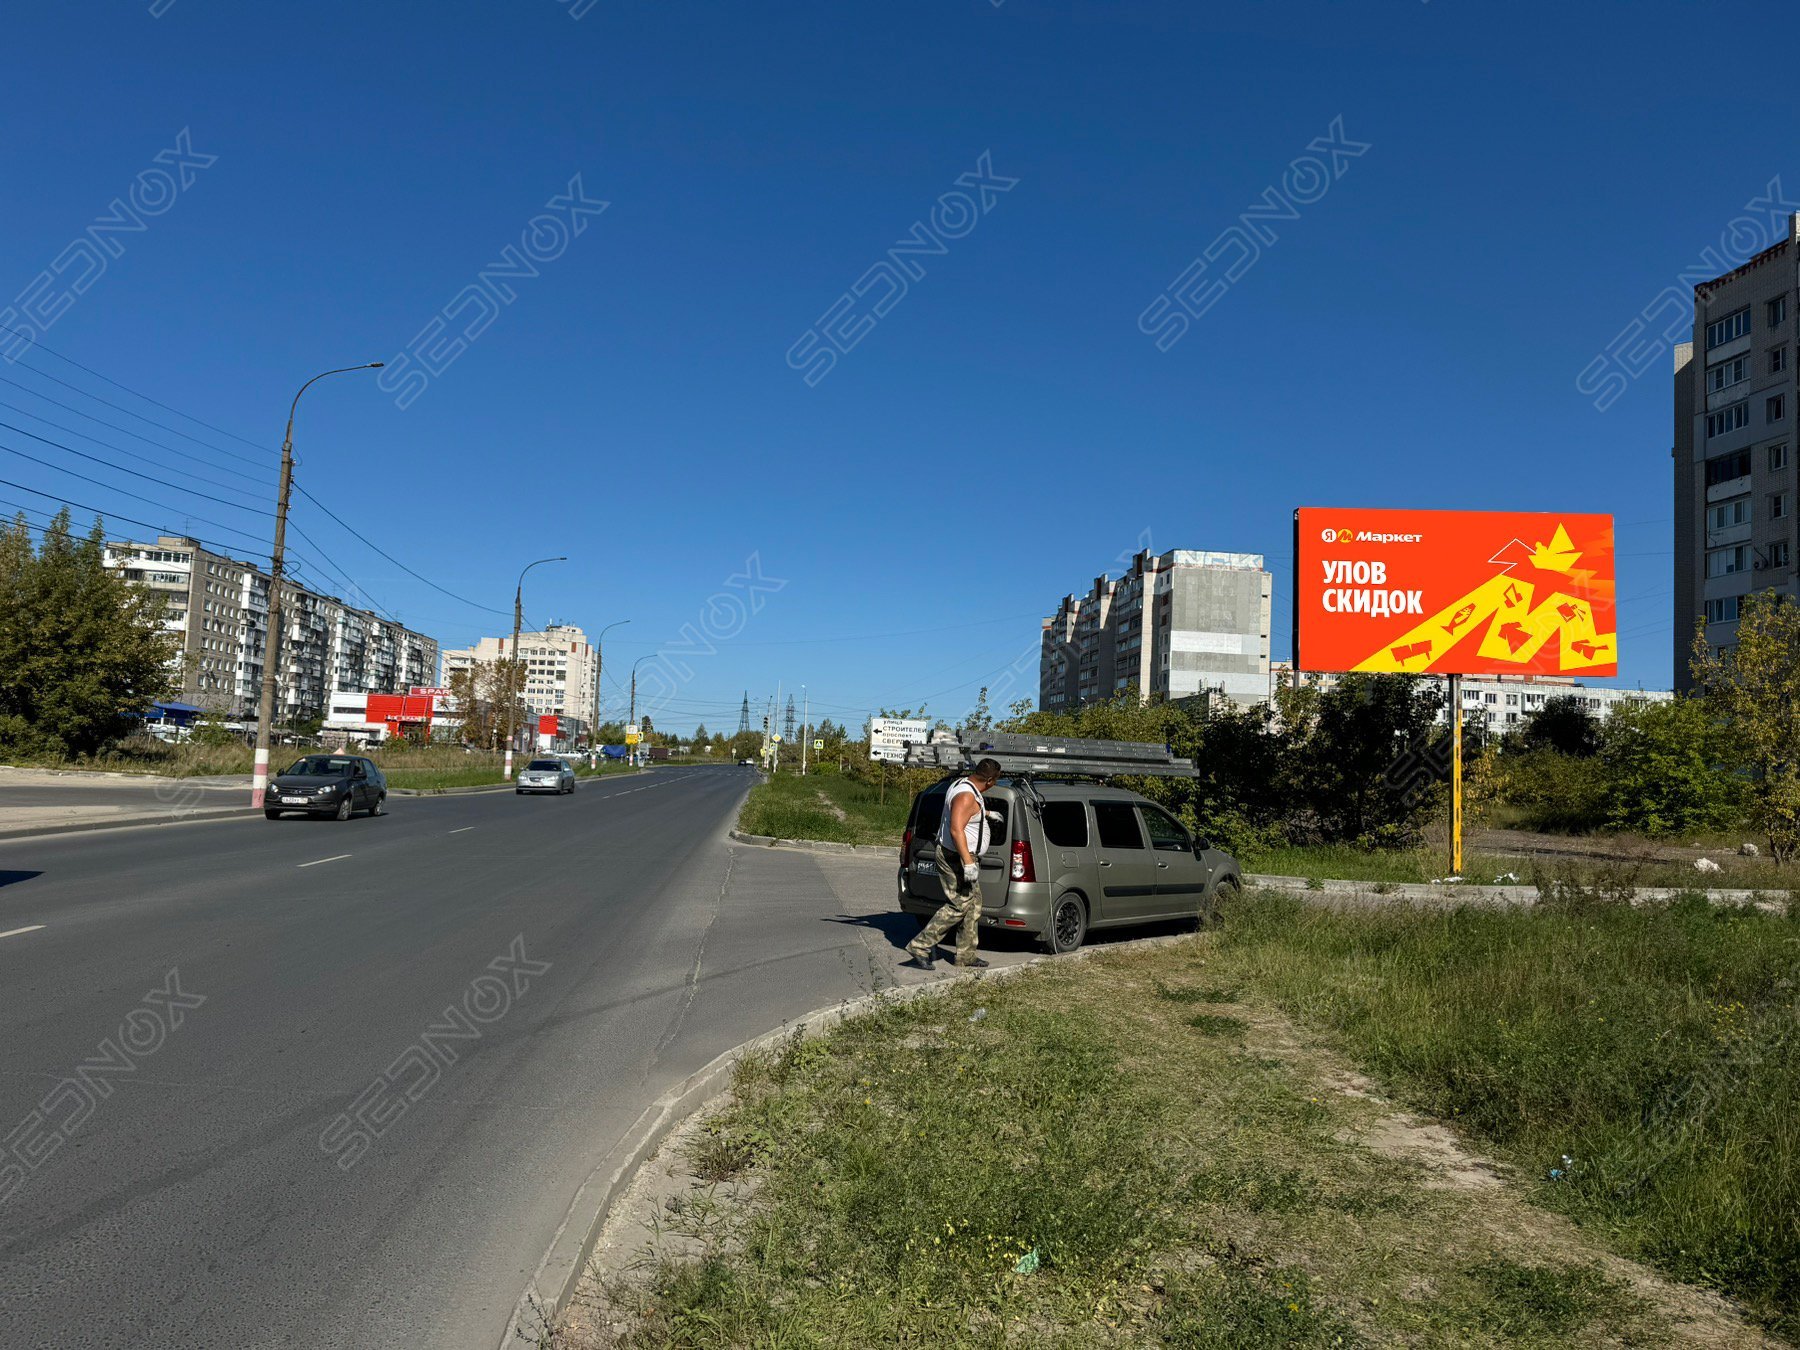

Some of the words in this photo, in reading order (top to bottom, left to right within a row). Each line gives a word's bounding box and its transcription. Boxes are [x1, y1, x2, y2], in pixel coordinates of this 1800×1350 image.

[1355, 531, 1423, 544] Маркет
[1321, 560, 1387, 585] УЛОВ
[1322, 588, 1424, 618] СКИДОК
